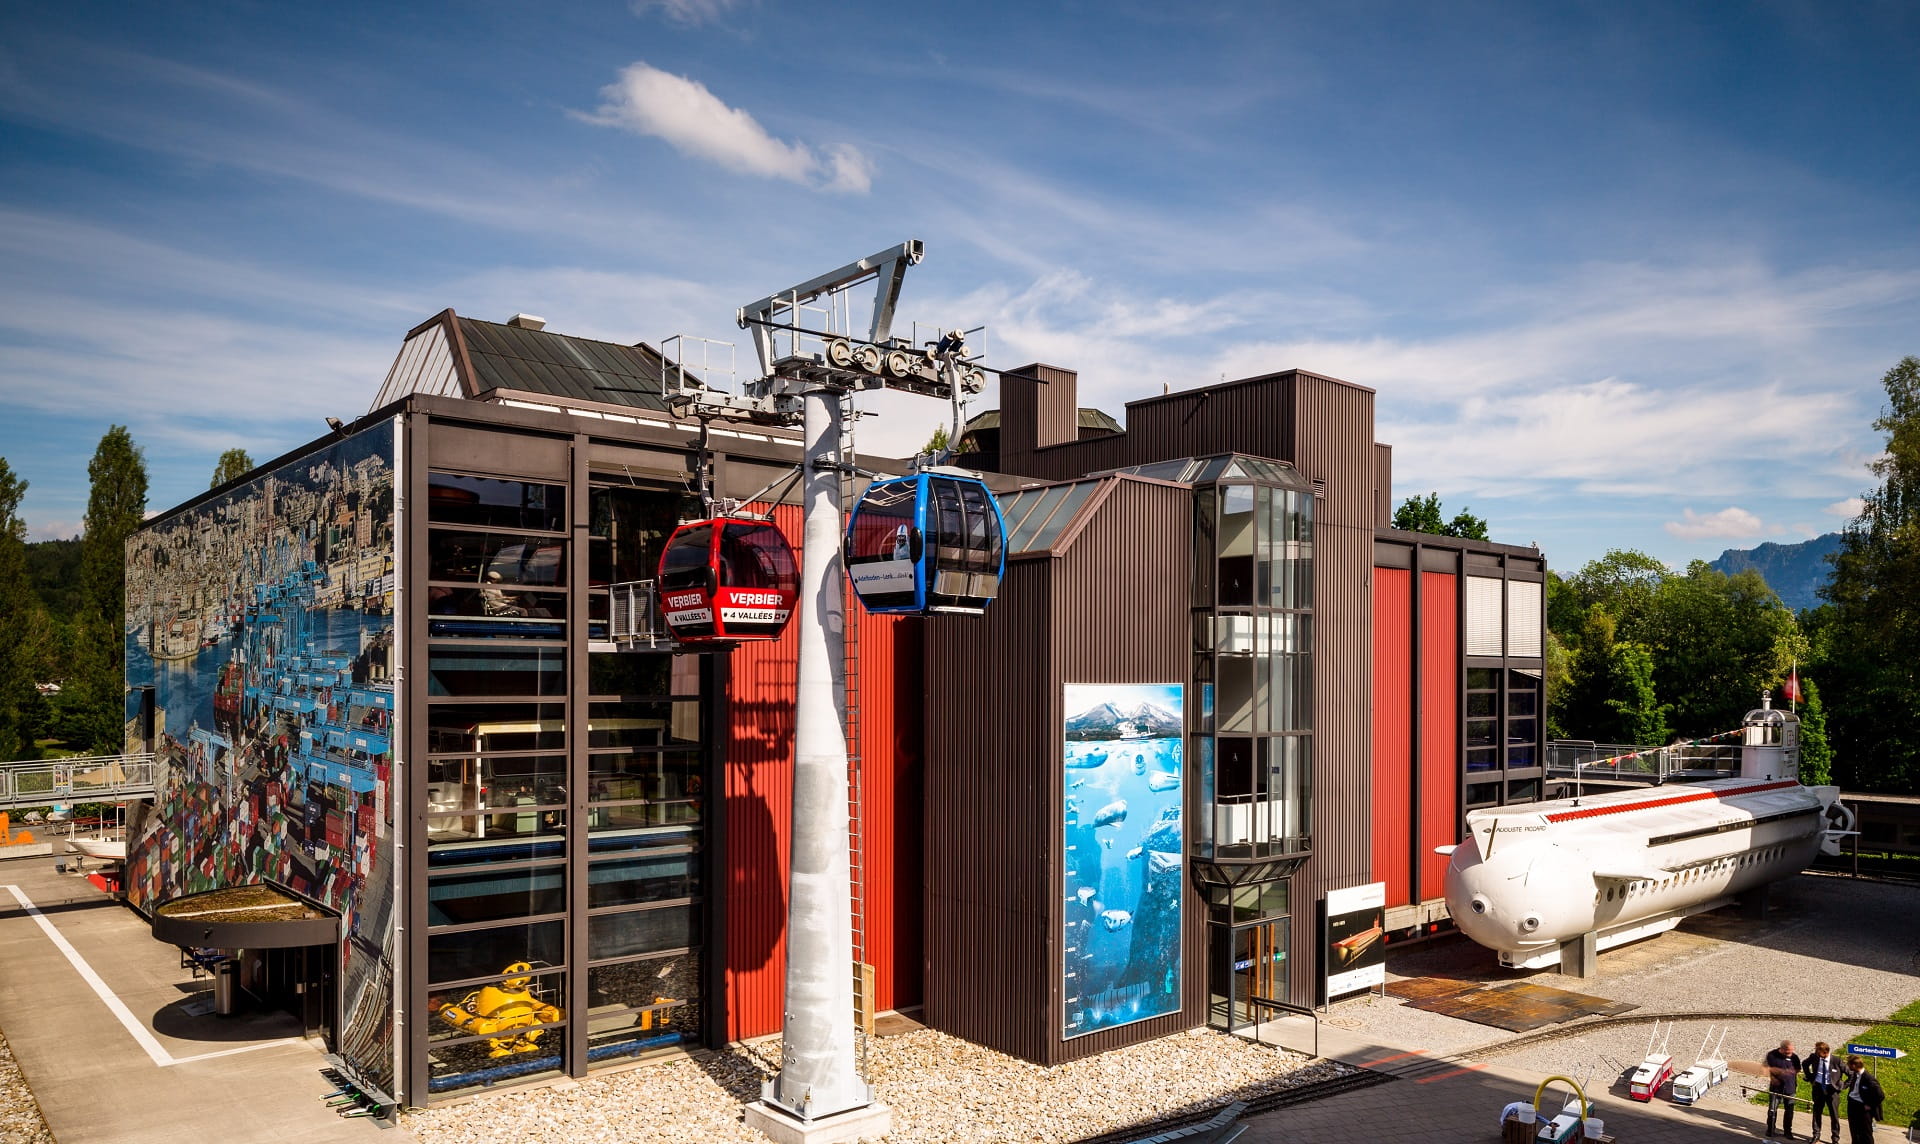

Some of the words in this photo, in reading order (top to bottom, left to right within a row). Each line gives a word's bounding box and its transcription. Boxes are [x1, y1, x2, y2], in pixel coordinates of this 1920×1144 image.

[668, 593, 702, 609] VERBIER
[729, 592, 783, 606] VERBIER
[730, 611, 736, 619] 4
[738, 610, 773, 620] VALLÉES
[1853, 1046, 1891, 1055] Gartenbahn
